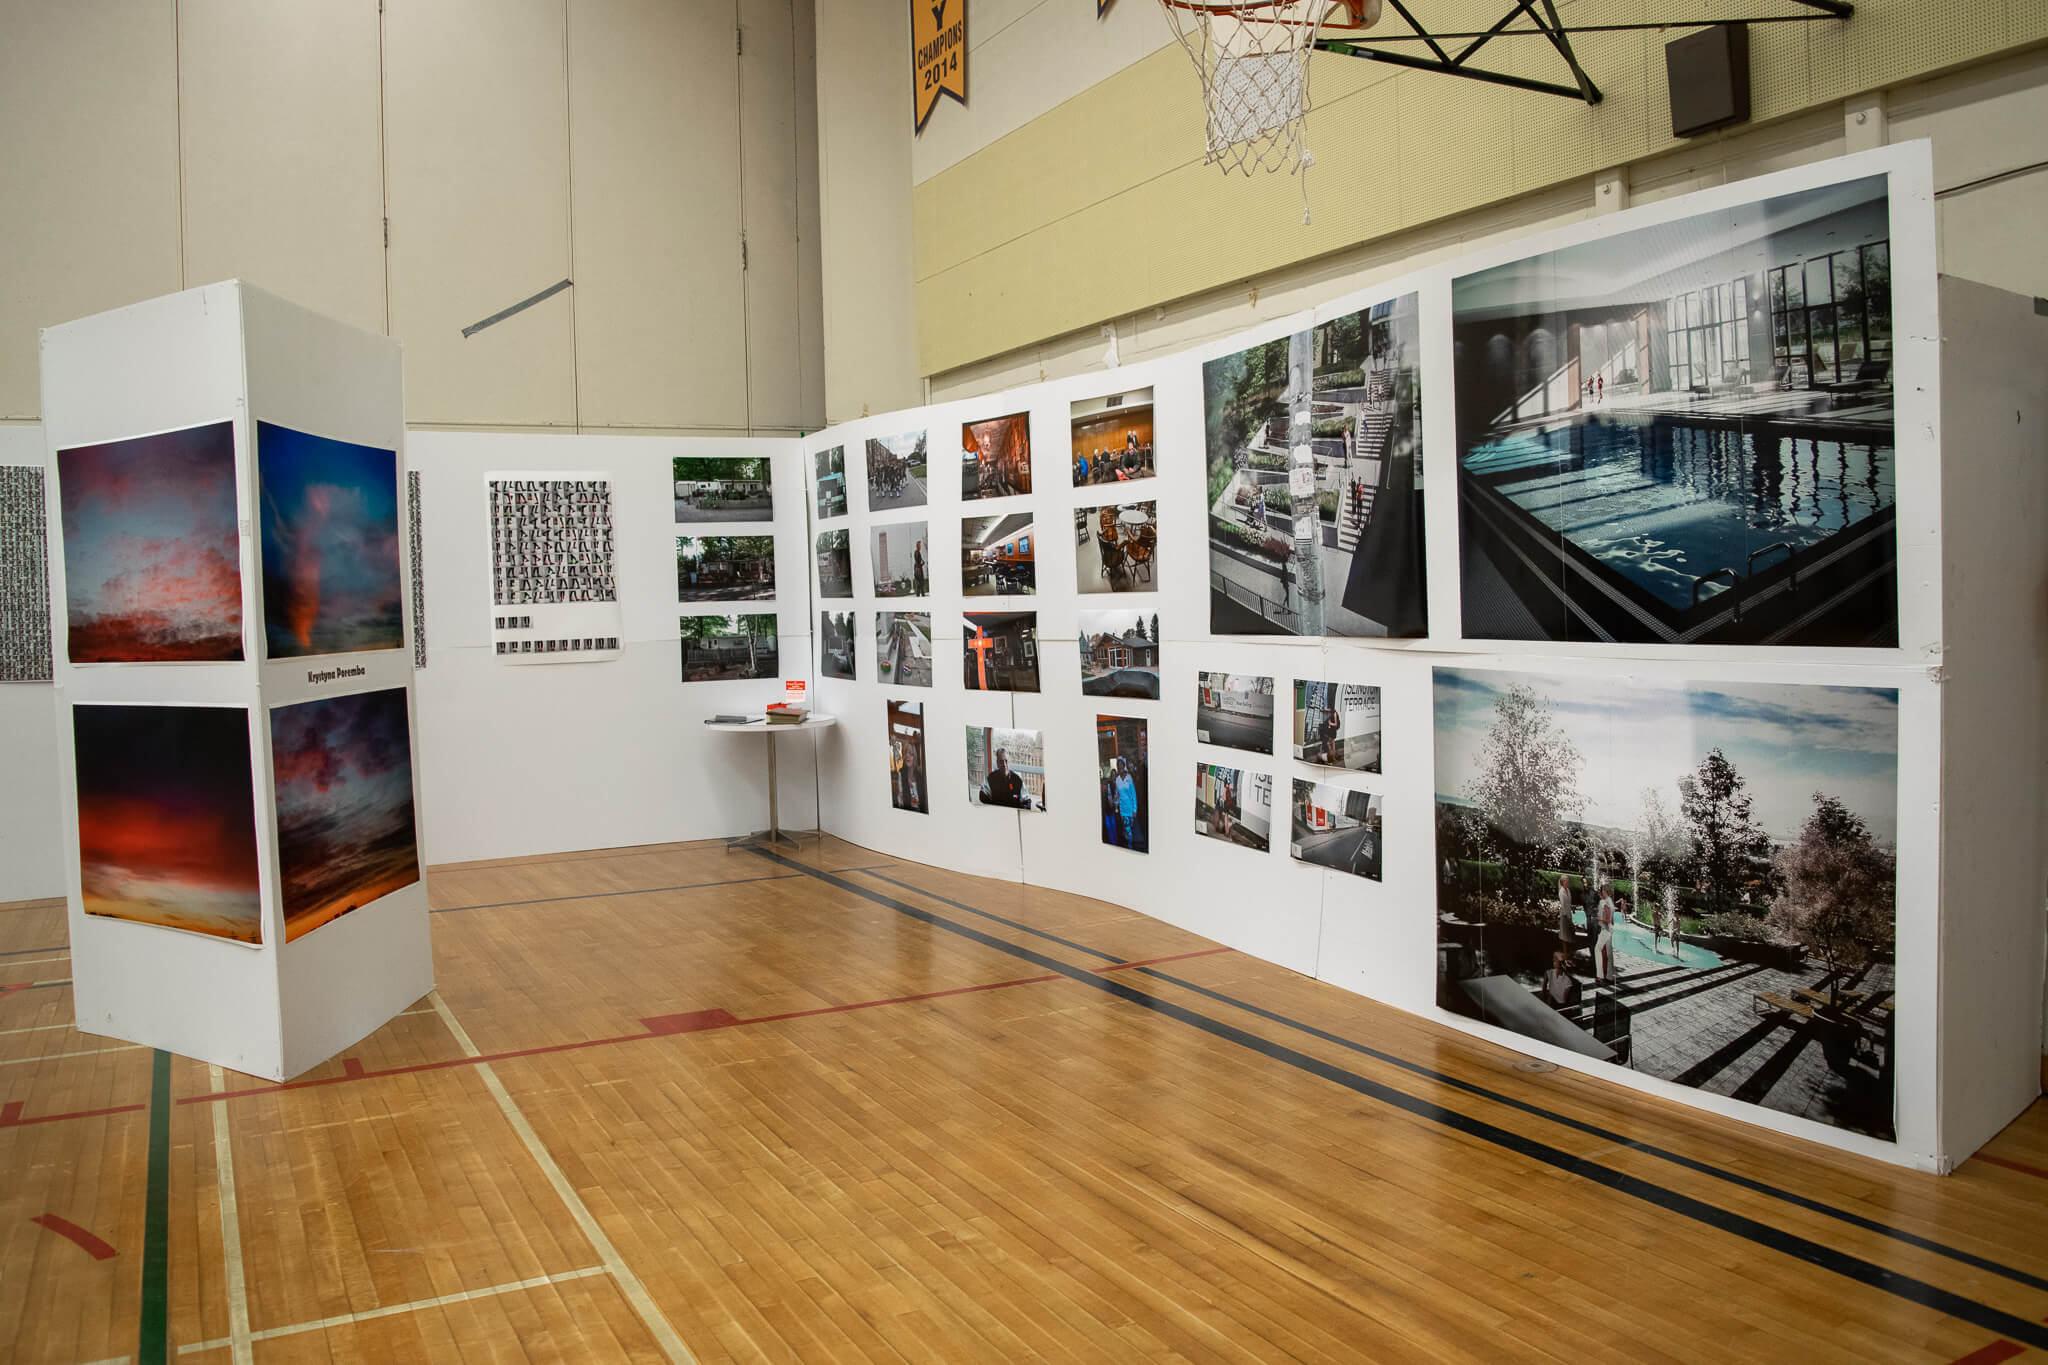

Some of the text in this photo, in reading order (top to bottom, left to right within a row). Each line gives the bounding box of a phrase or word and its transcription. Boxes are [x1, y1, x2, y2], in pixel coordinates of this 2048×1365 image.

[918, 20, 962, 70] CHAMPIONS
[925, 51, 958, 90] 2014
[308, 665, 366, 684] Krystyna Poremba
